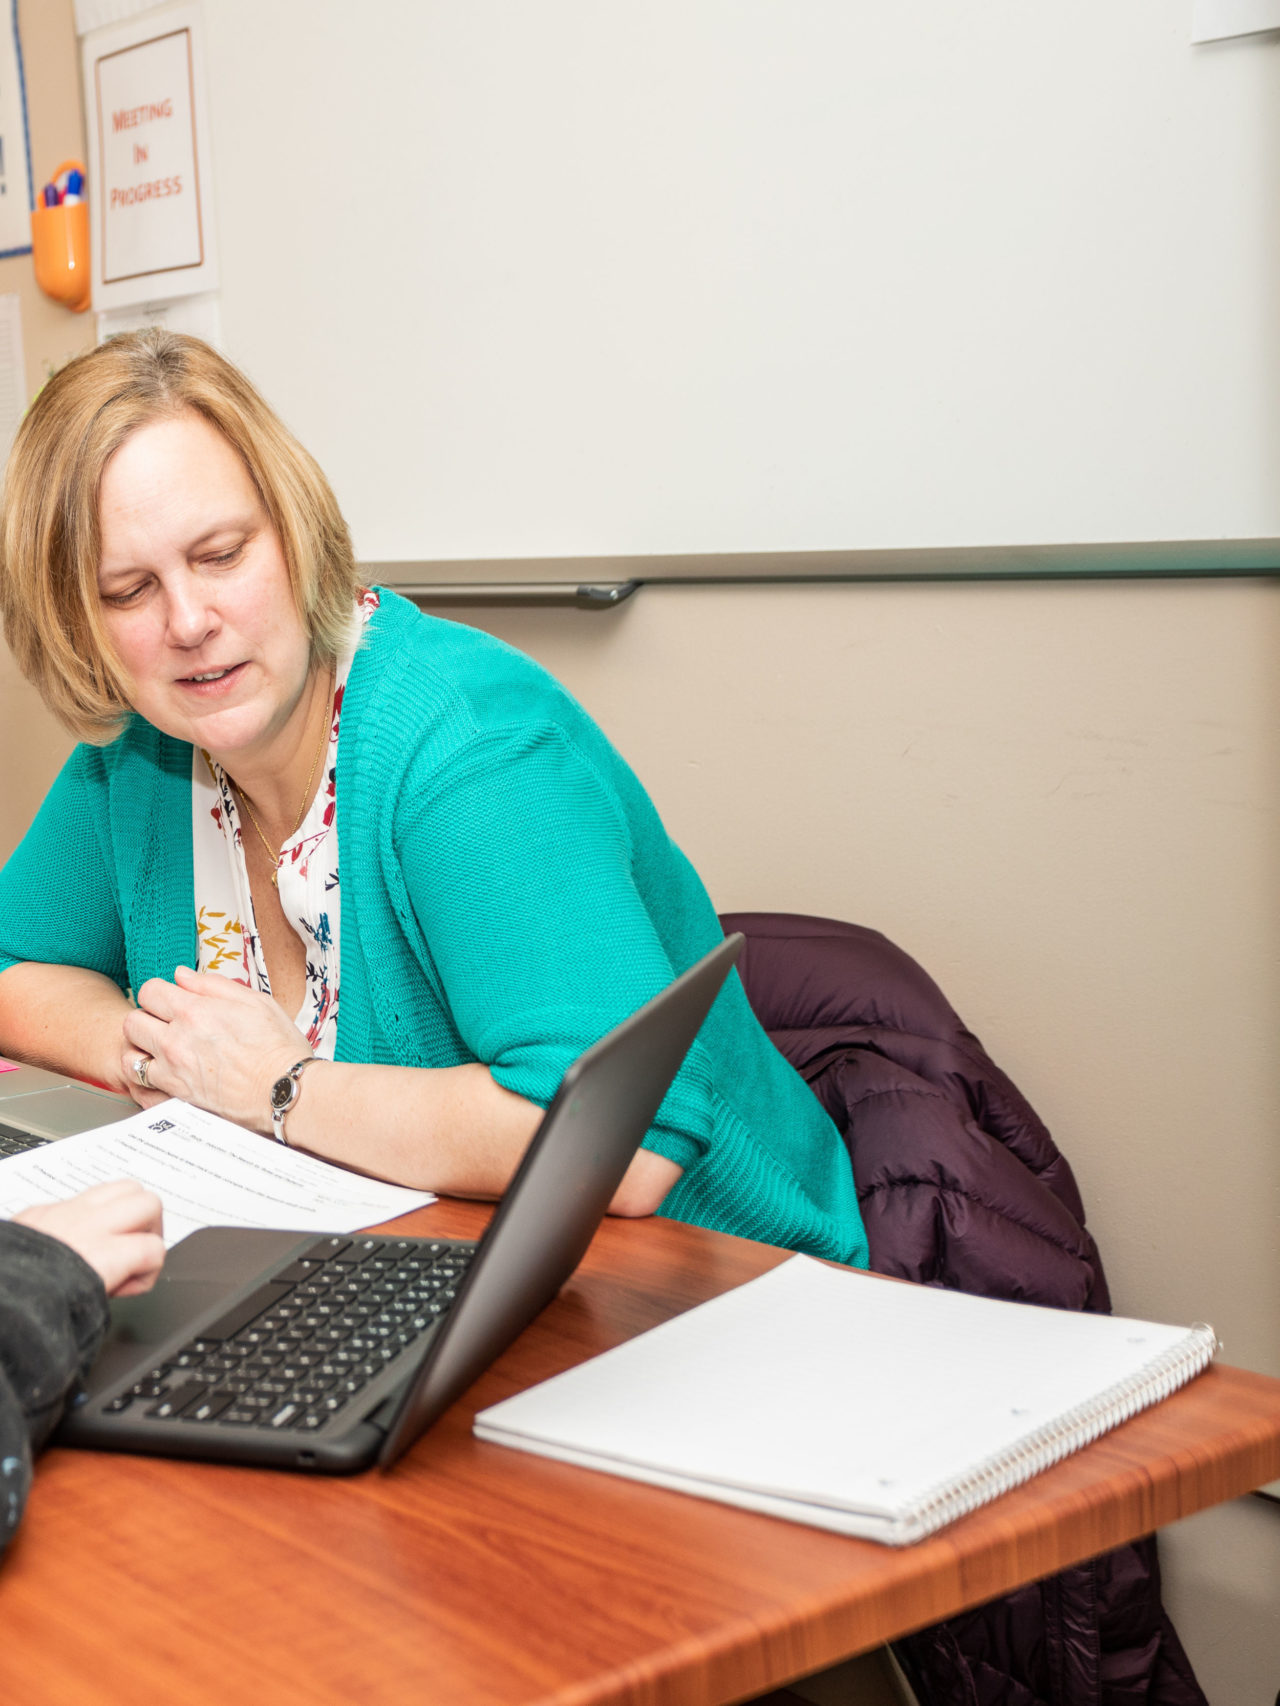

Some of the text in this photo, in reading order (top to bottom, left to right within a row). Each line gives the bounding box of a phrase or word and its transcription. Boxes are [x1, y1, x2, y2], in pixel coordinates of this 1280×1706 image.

[112, 98, 173, 133] MEETING
[133, 144, 149, 165] IN
[110, 175, 182, 210] PROGRESS
